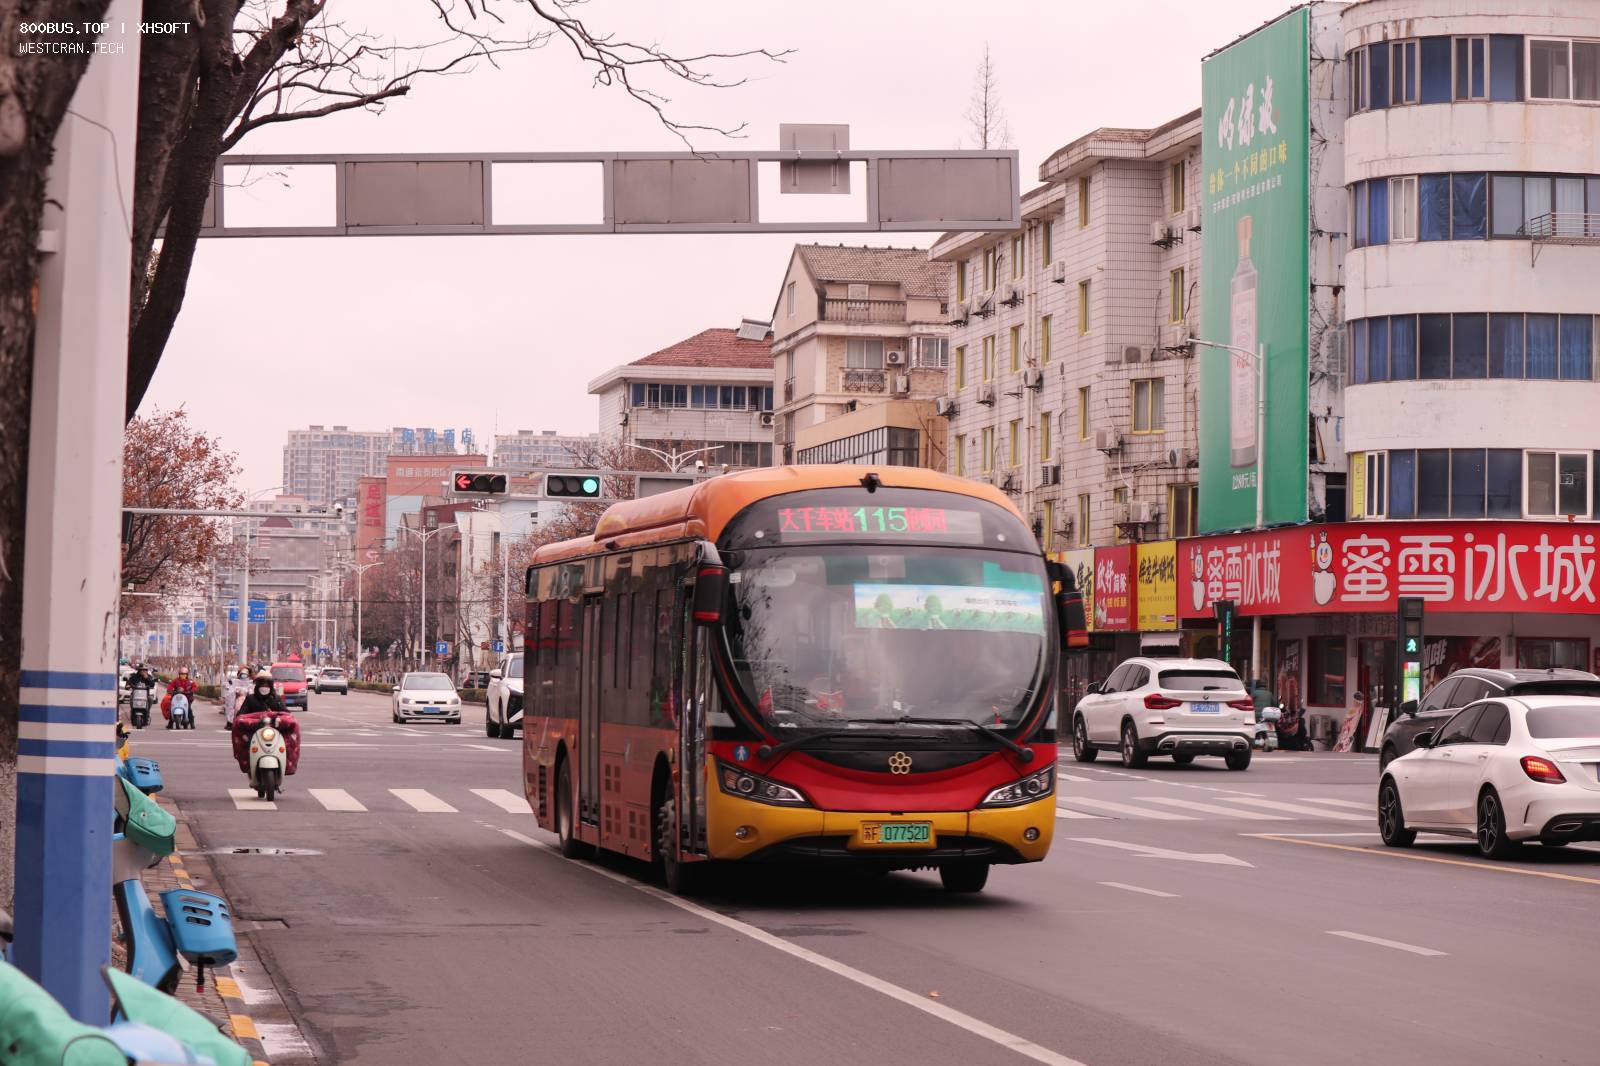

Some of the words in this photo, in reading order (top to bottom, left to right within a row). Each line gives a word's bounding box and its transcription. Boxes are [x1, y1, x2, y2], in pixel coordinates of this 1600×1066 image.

[854, 507, 908, 532] 115
[1207, 540, 1281, 607] 蜜雪冰城
[1341, 532, 1597, 603] 蜜雪冰城
[885, 825, 929, 841] 07752D
